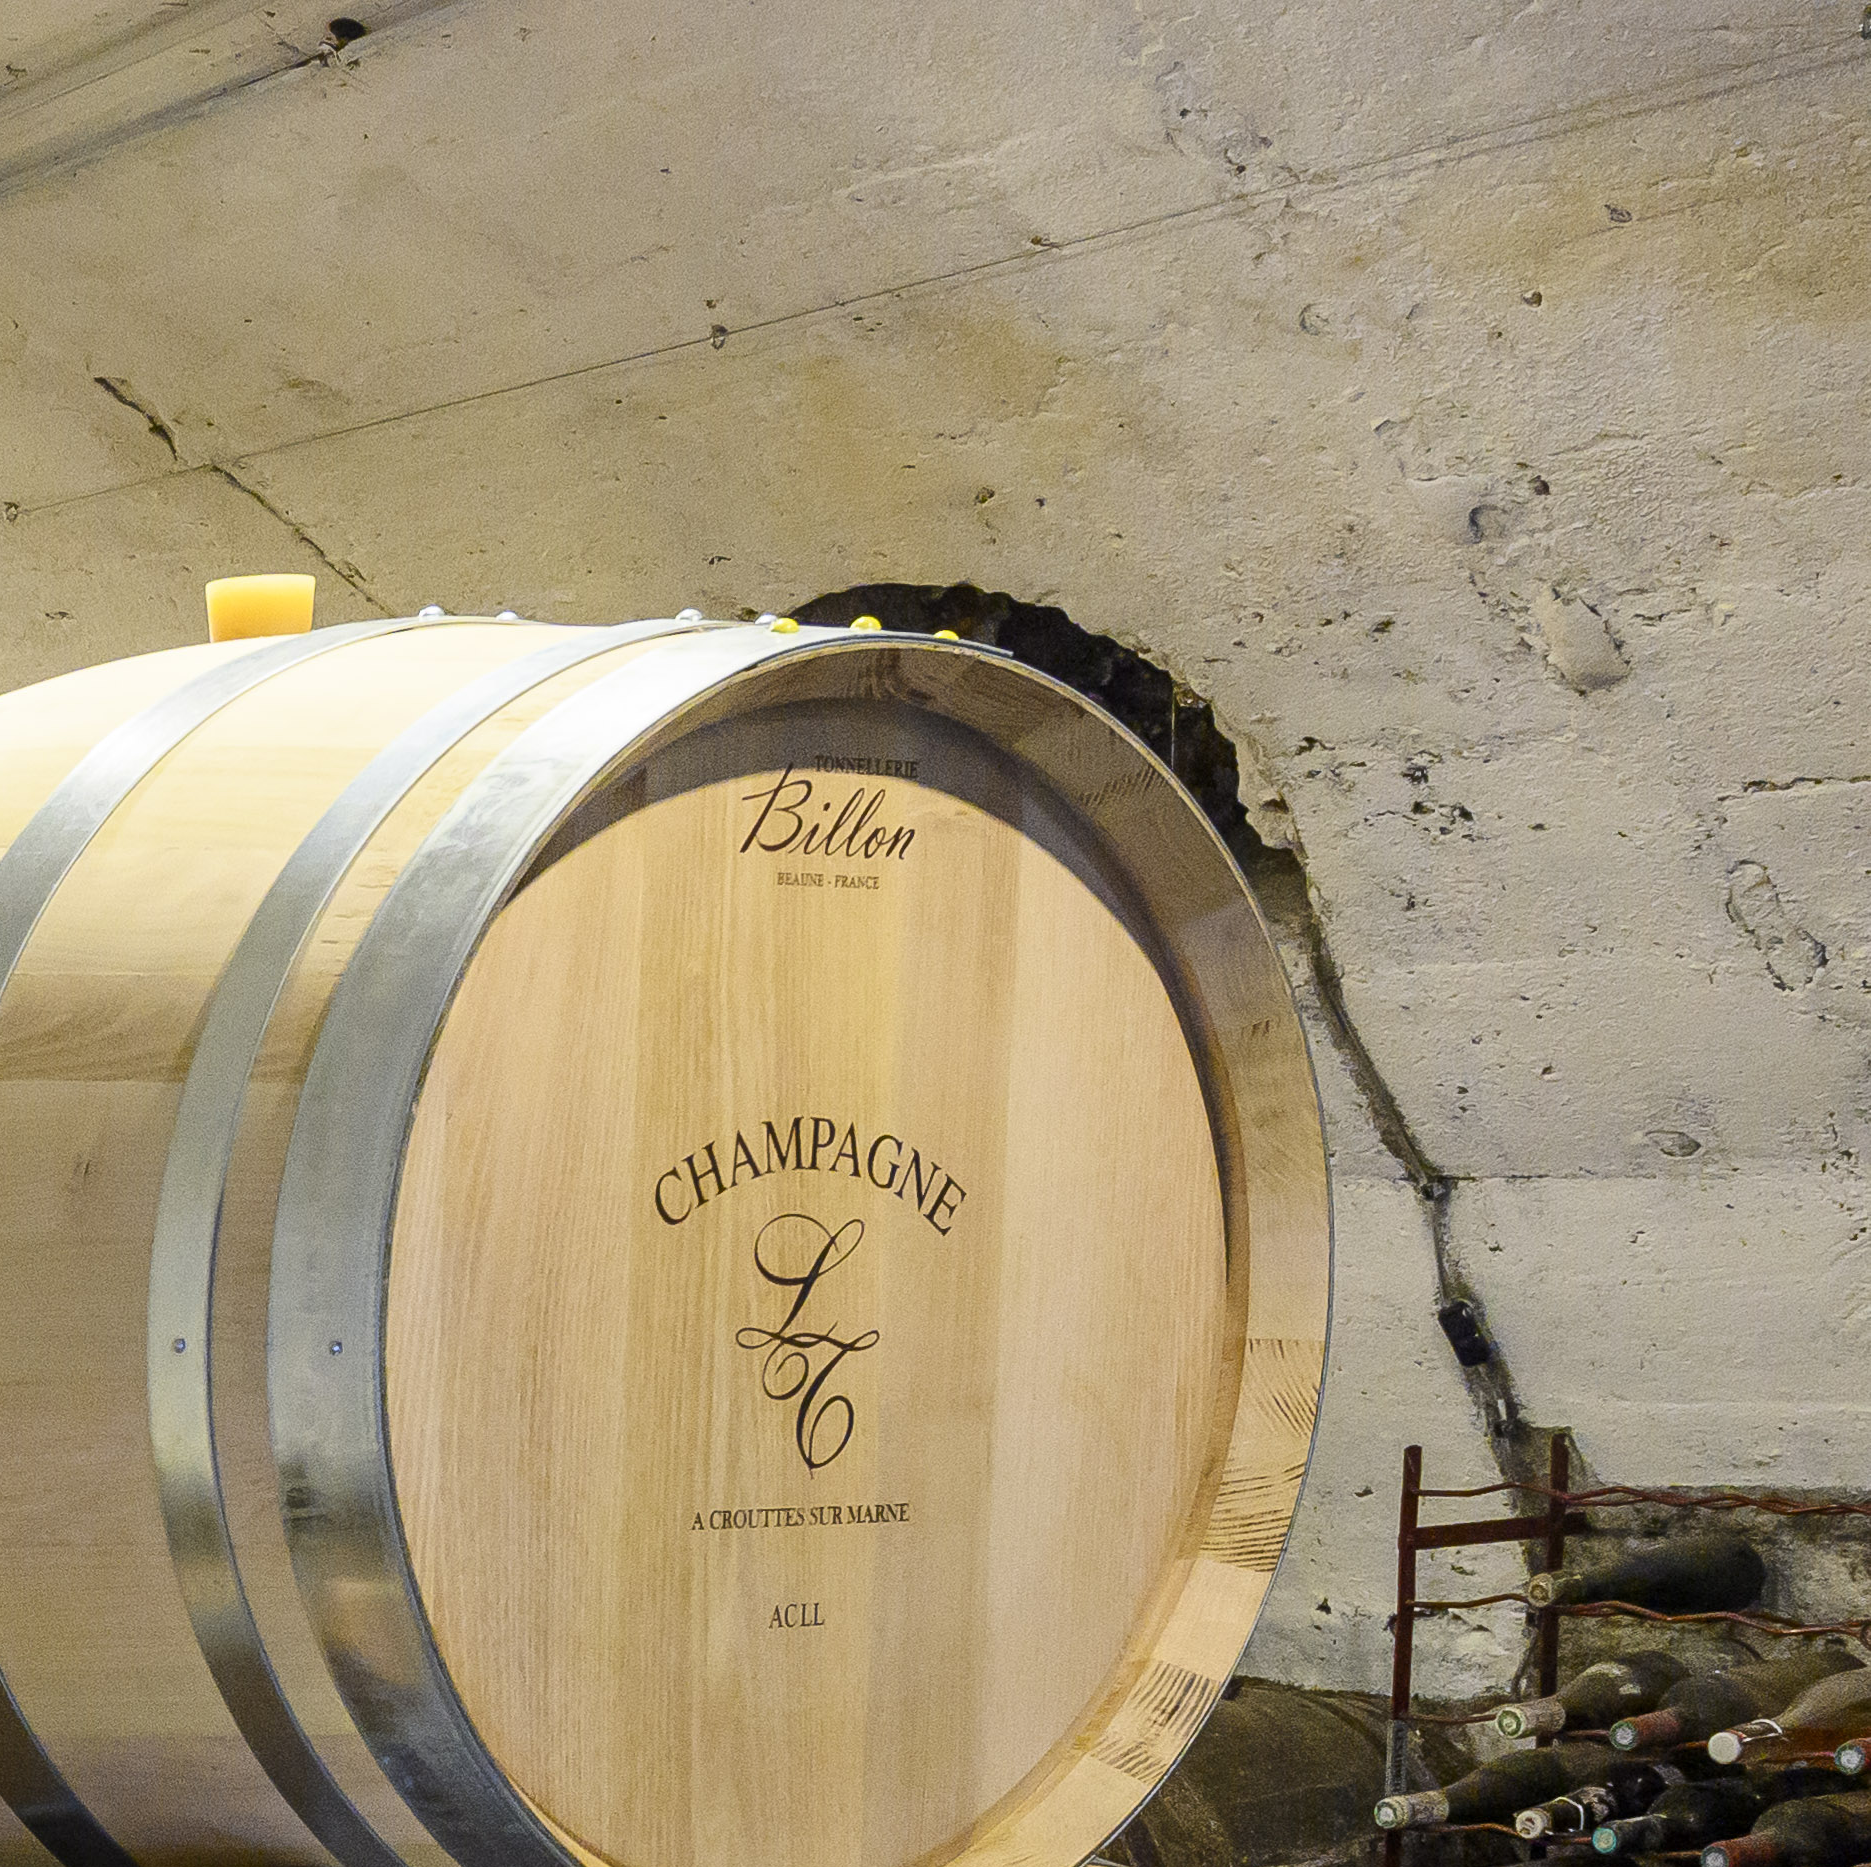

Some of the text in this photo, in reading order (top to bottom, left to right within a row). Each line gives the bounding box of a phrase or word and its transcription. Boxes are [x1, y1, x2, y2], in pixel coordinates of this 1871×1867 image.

[814, 755, 918, 778] TONNELLERIE
[739, 761, 916, 860] Billon
[777, 872, 824, 887] BEAUNE
[835, 875, 880, 889] FRANCE
[654, 1116, 967, 1237] CHAMPAGNE
[692, 1503, 910, 1530] A CROUTTES SUR MARNE
